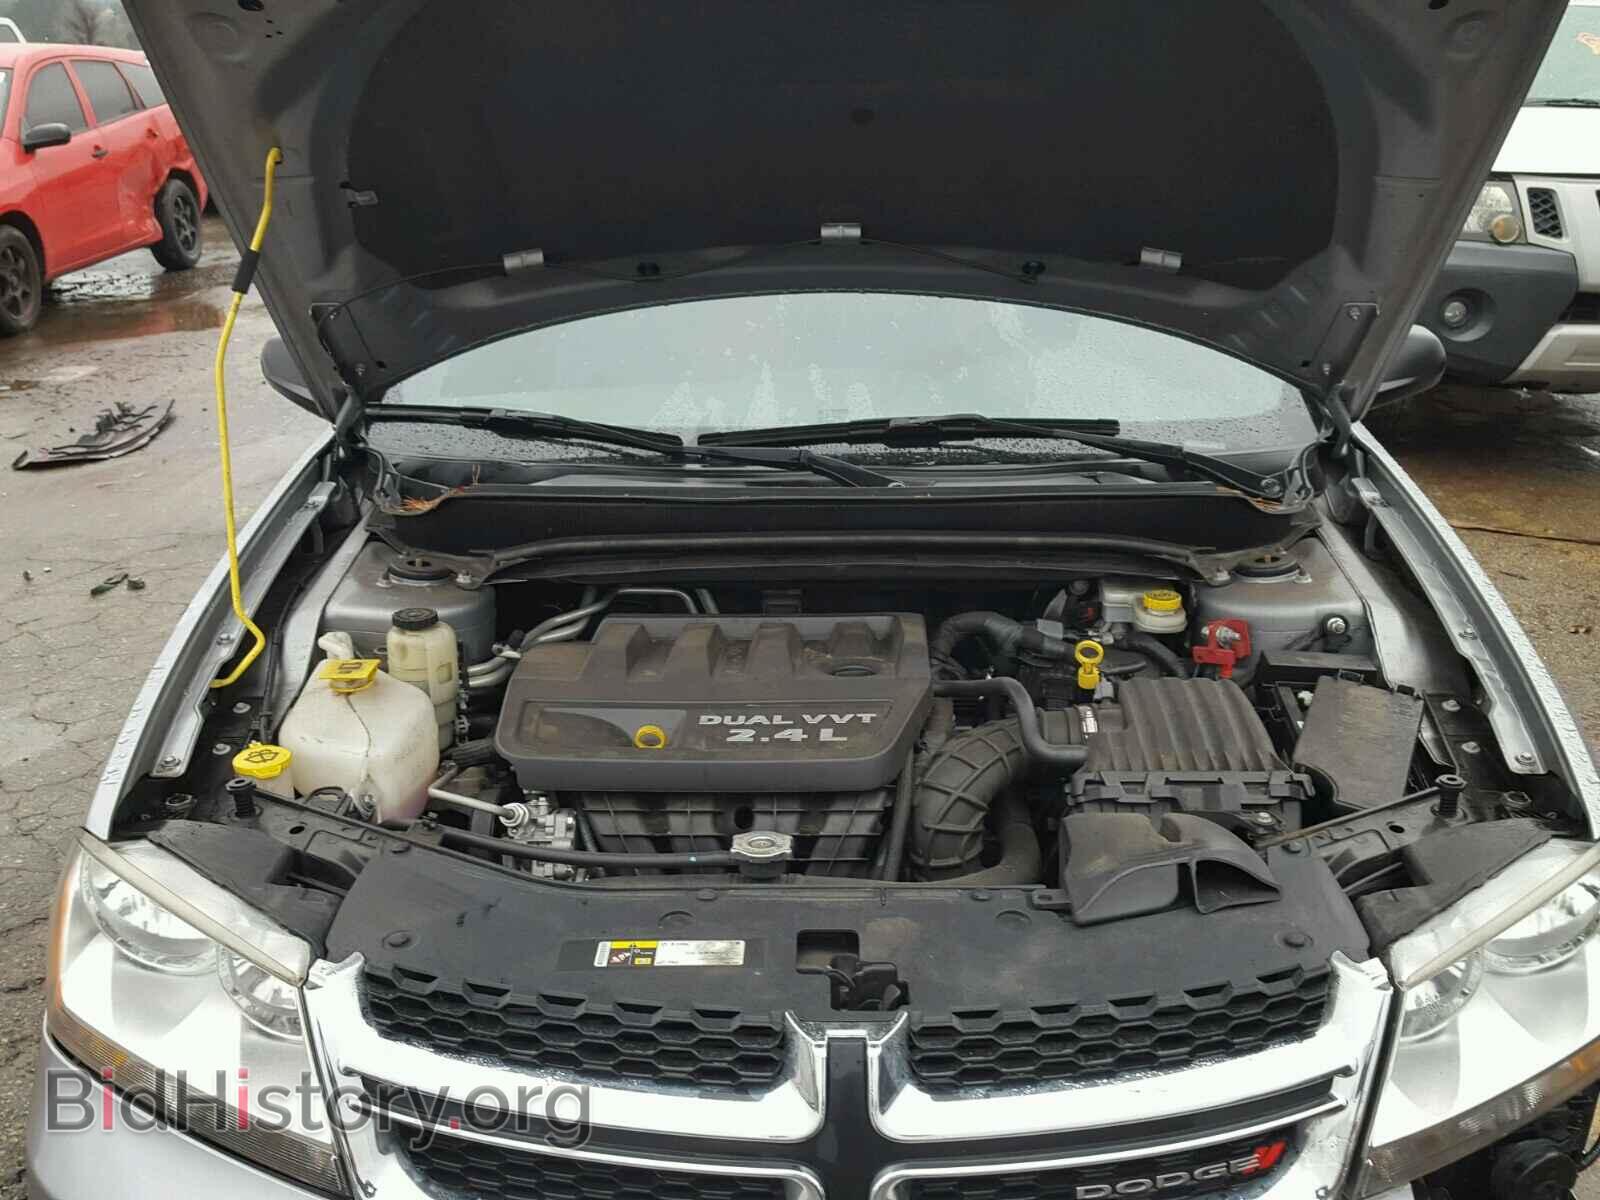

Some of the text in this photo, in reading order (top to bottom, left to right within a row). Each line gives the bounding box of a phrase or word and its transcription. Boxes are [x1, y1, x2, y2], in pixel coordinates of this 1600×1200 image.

[698, 713, 878, 726] DUAL VVT
[1075, 1153, 1261, 1200] DODGE
